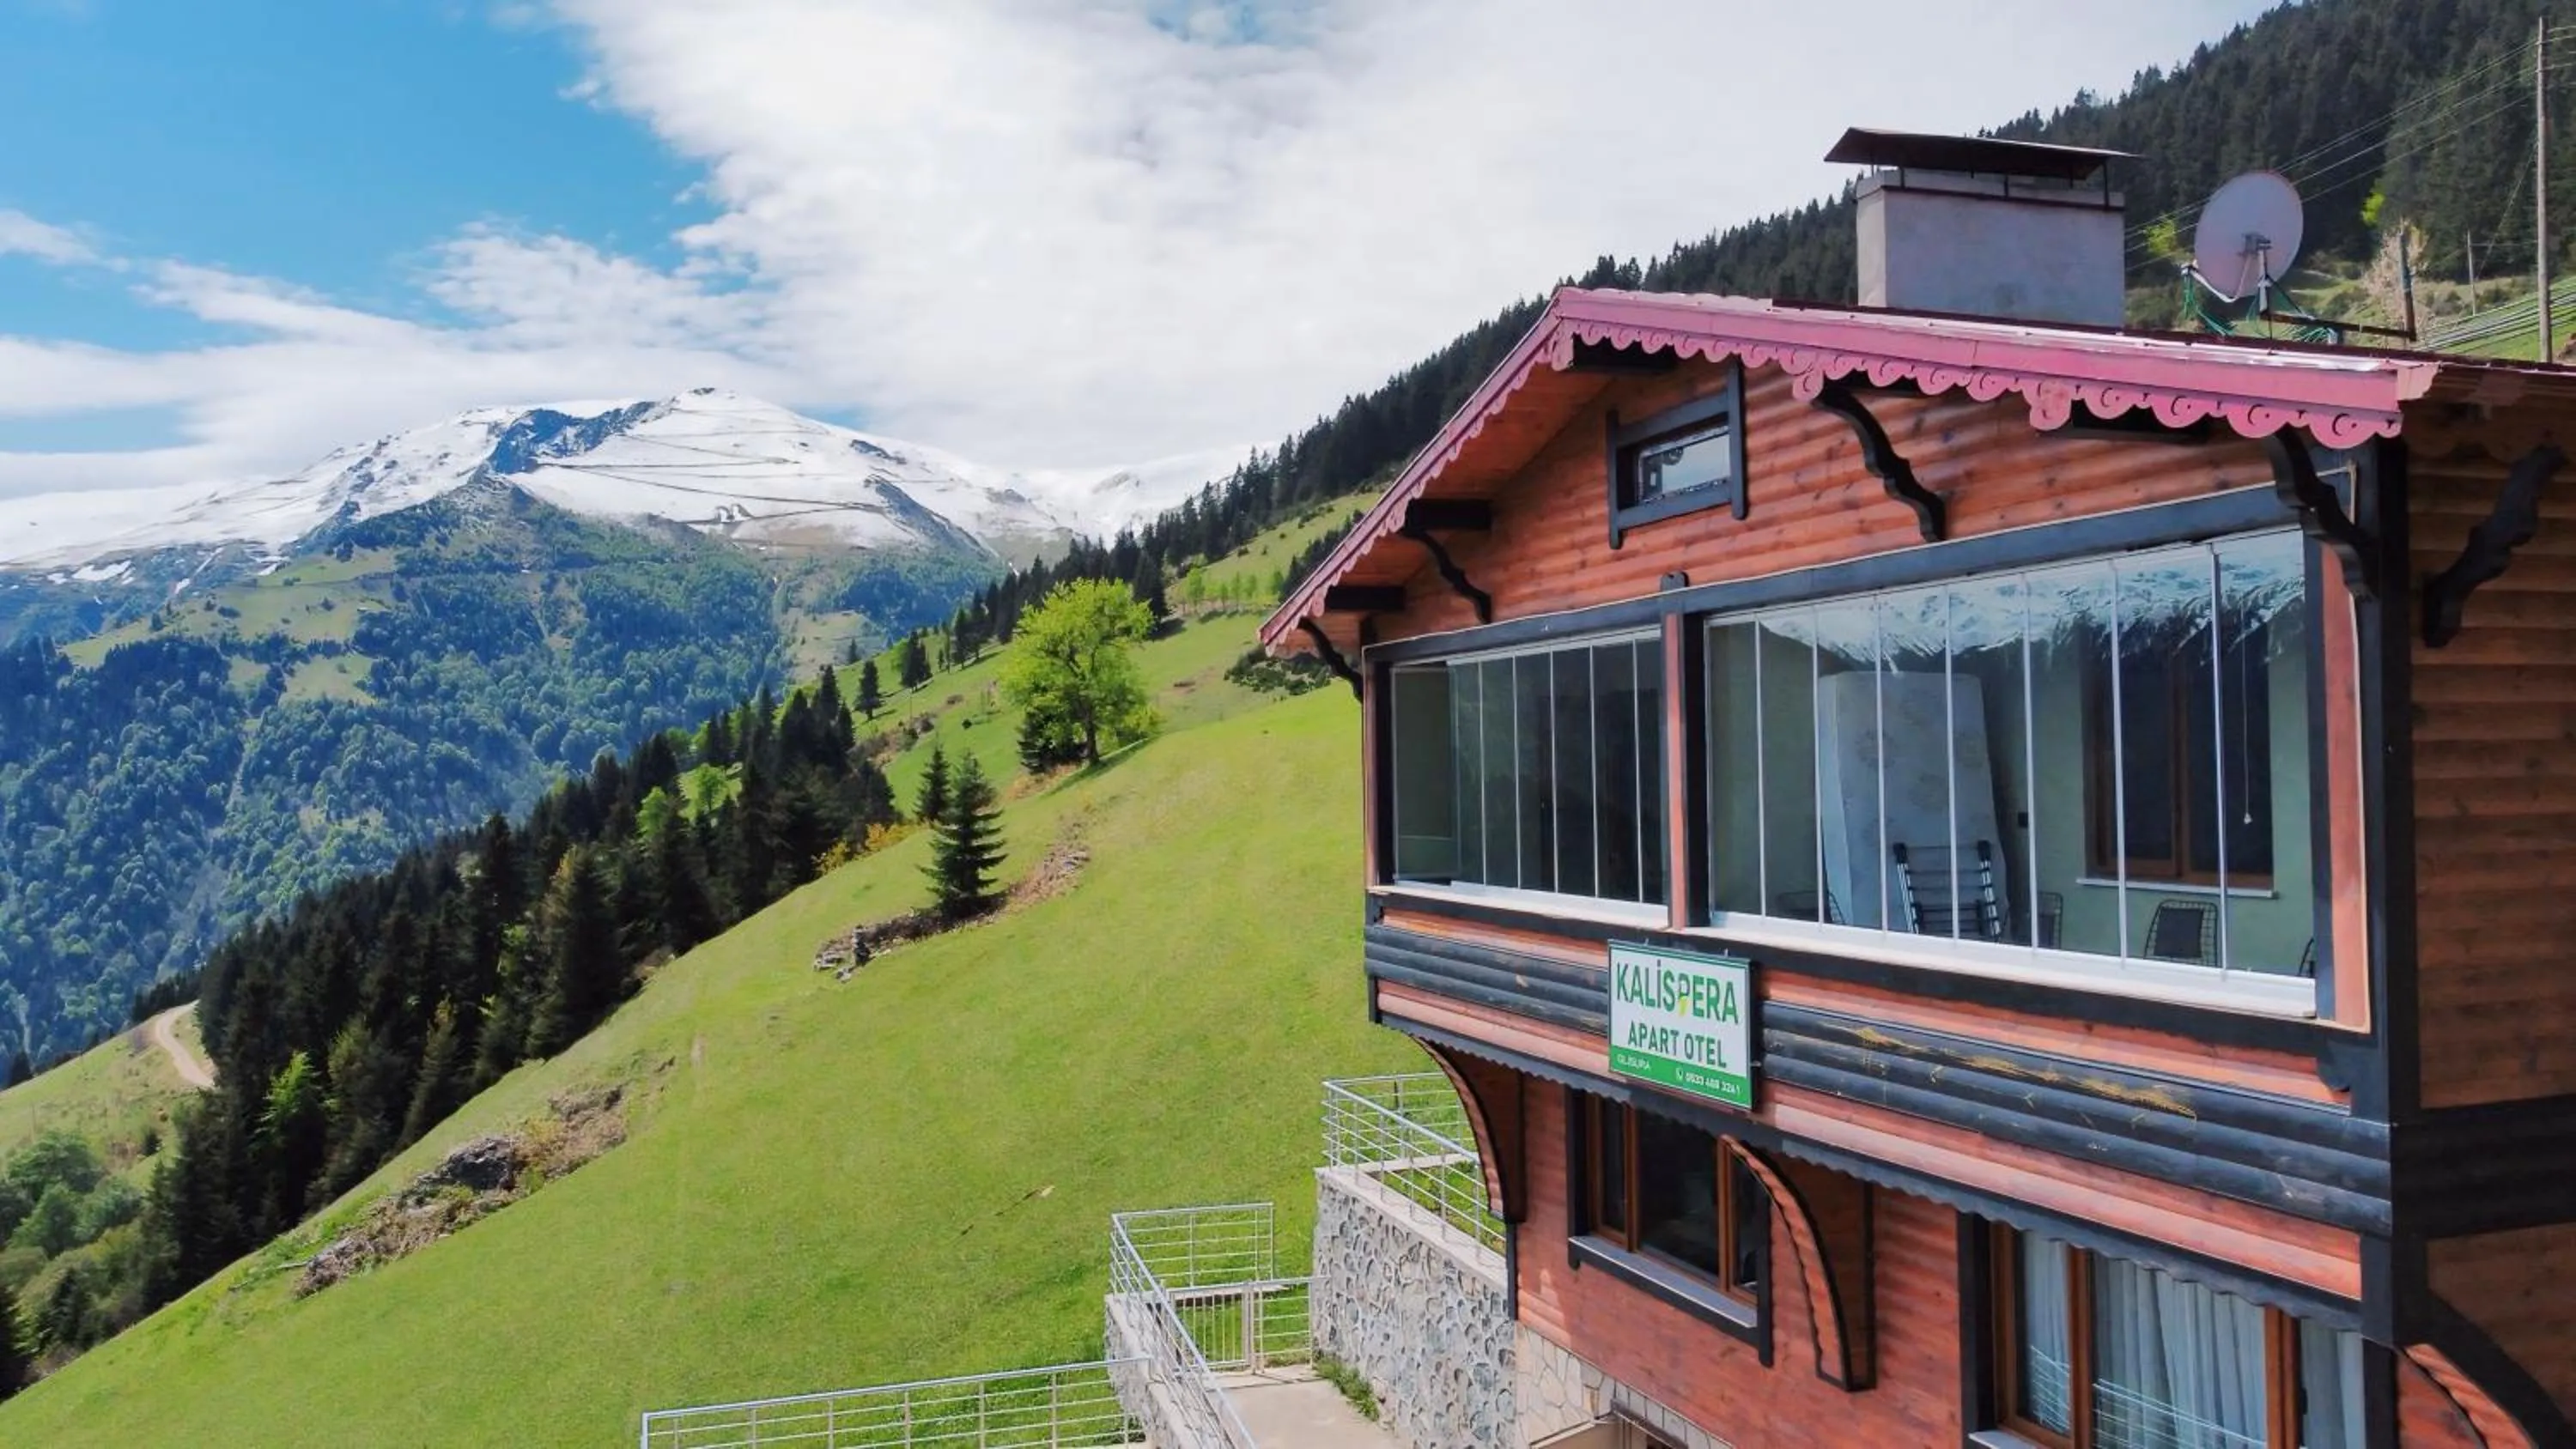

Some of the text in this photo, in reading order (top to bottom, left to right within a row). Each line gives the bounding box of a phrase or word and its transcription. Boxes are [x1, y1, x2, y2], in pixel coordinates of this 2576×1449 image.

[1617, 959, 1739, 1025] KALİSPERA
[1628, 1021, 1727, 1069] APART OTEL
